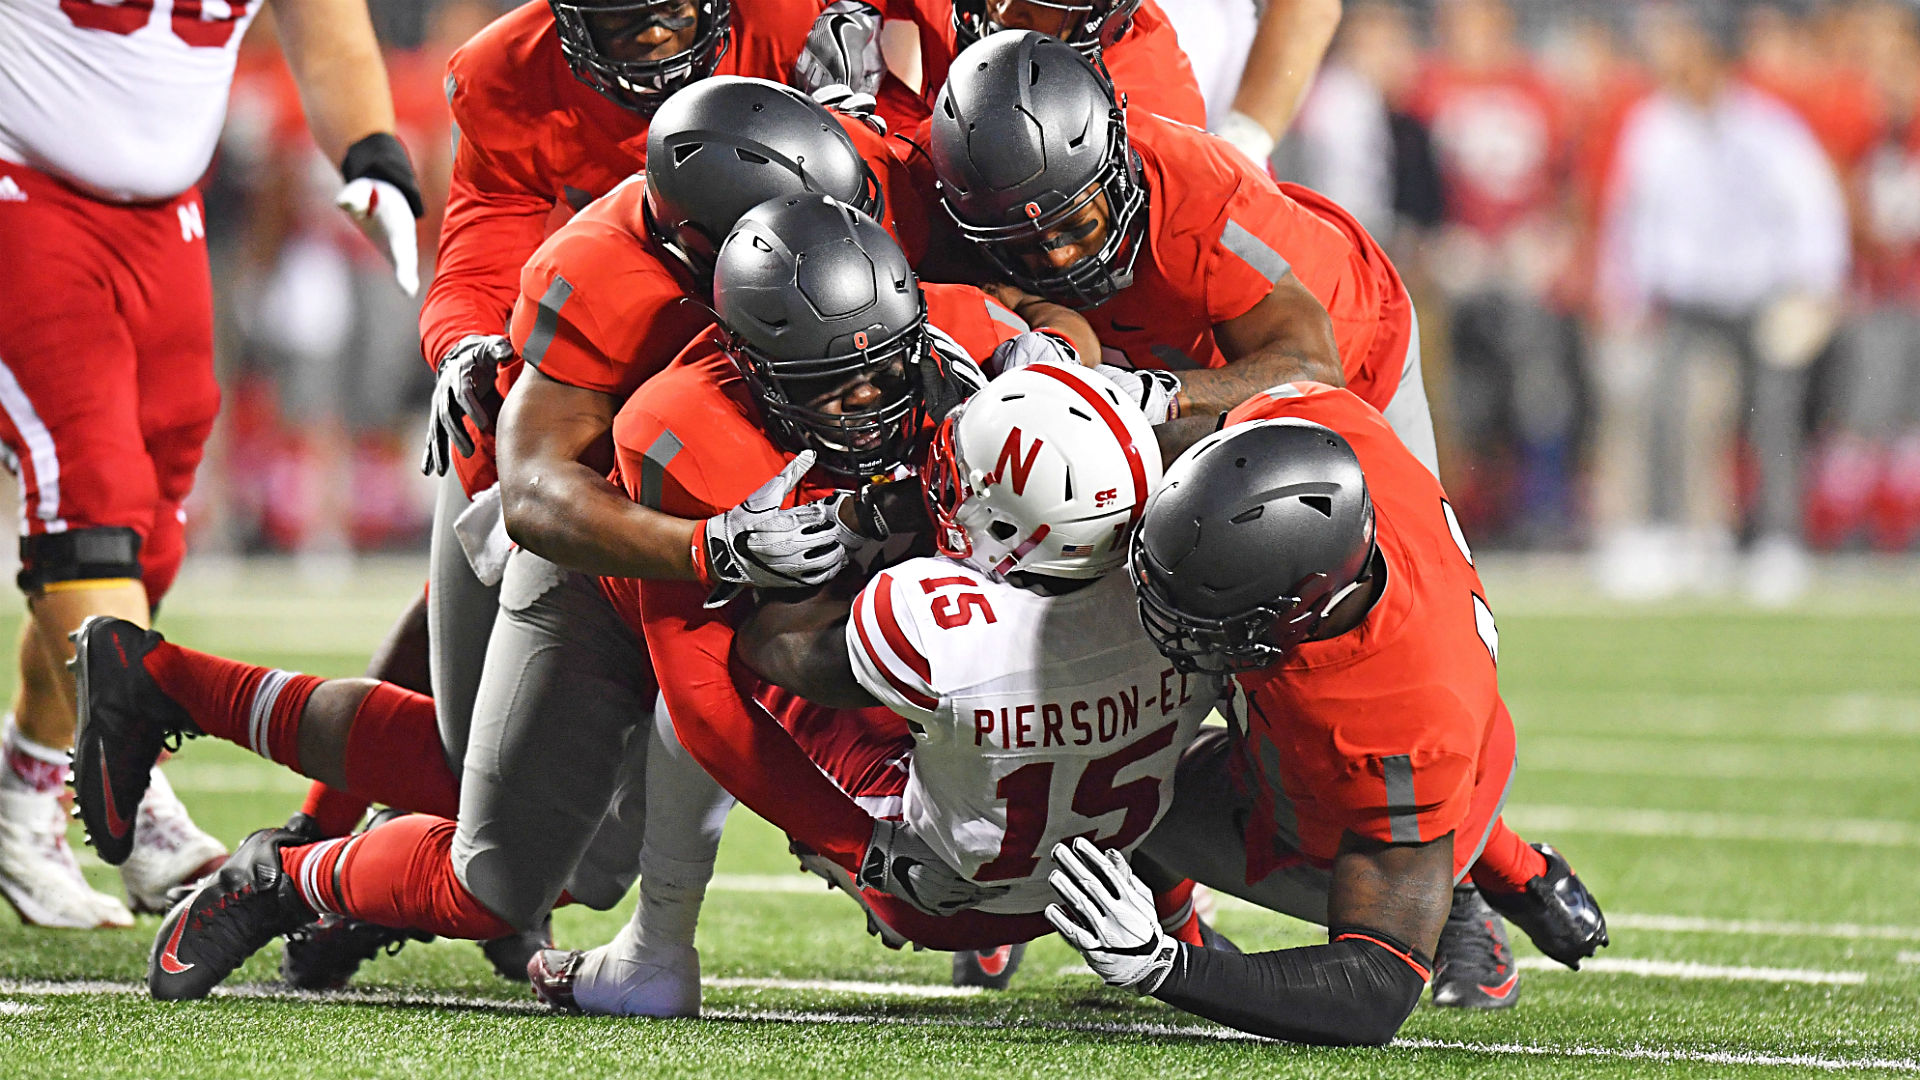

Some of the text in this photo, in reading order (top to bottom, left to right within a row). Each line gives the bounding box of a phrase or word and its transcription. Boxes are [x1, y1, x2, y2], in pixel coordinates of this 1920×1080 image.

[177, 201, 204, 242] N
[994, 426, 1043, 496] N
[919, 576, 997, 630] 15
[974, 667, 1192, 749] PIERSON-EL
[972, 719, 1179, 882] 15
